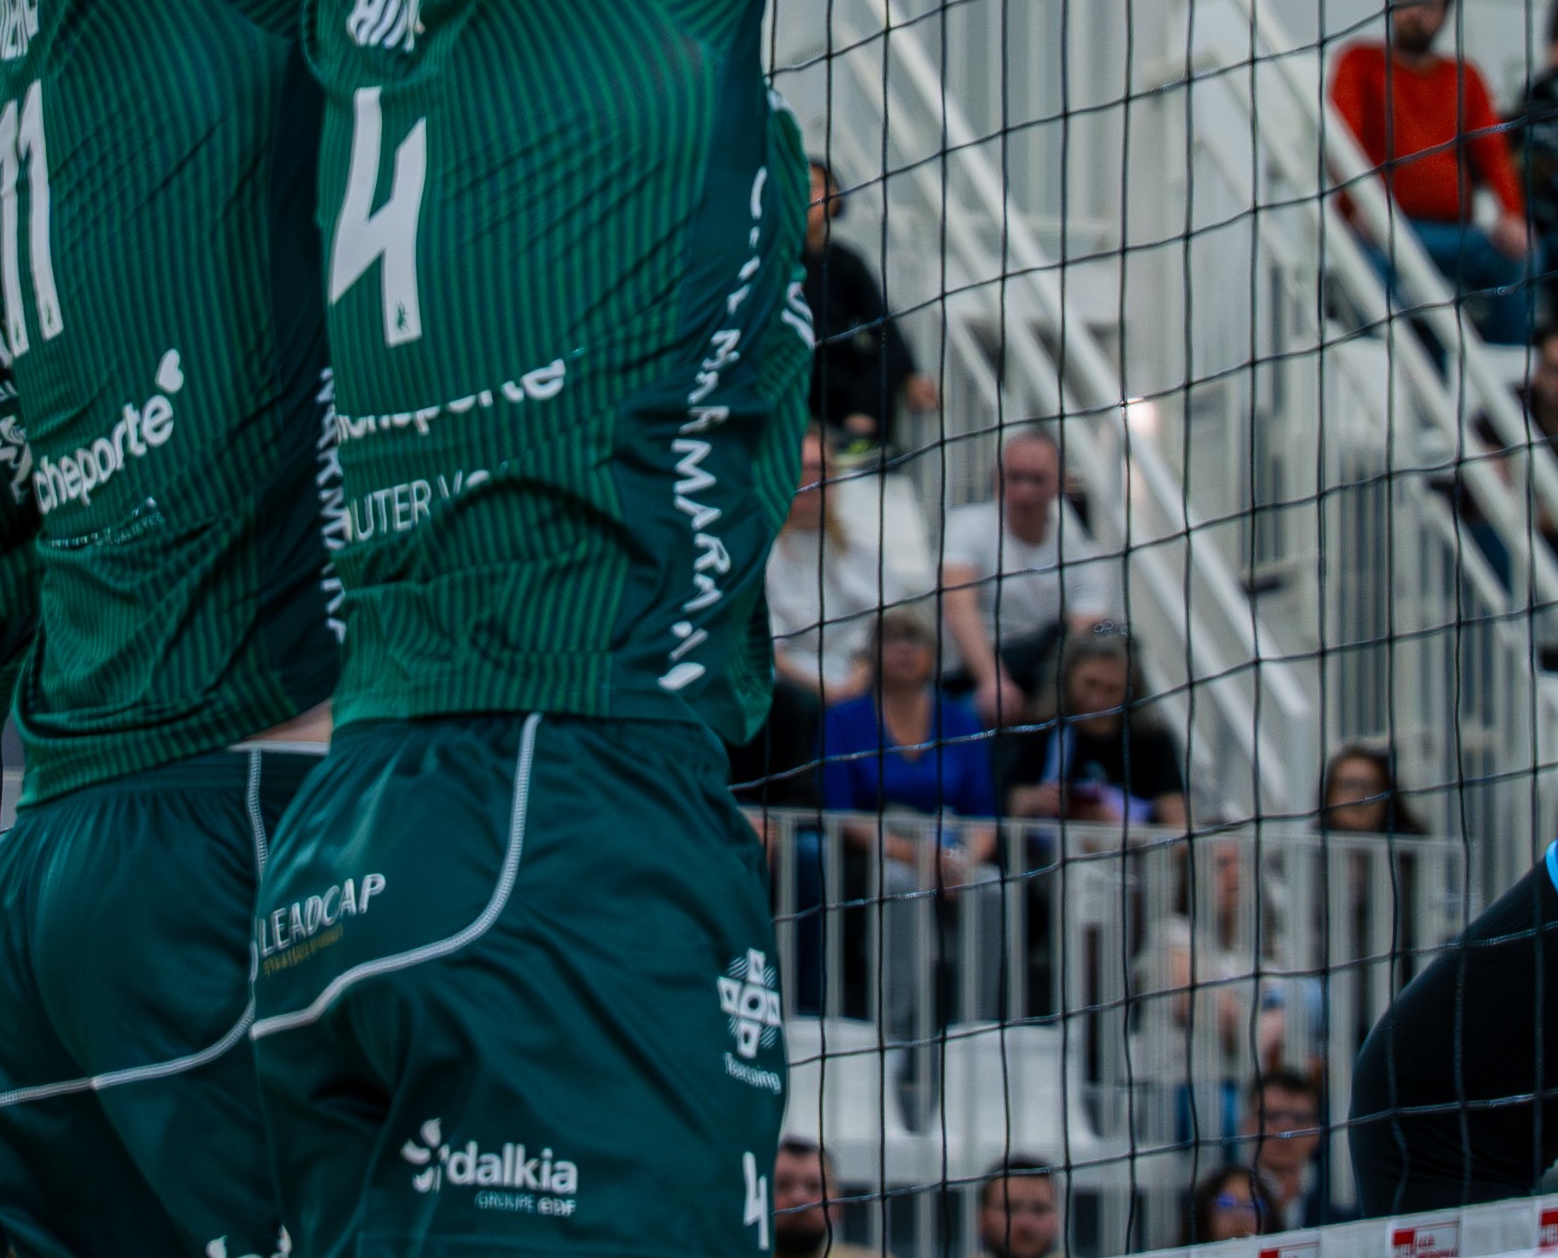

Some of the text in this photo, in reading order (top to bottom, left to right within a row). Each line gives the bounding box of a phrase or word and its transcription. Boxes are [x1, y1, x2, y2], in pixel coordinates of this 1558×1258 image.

[329, 85, 427, 347] 4
[258, 873, 386, 957] LEADCAP
[446, 1140, 579, 1194] dalkia
[742, 1150, 770, 1251] 4
